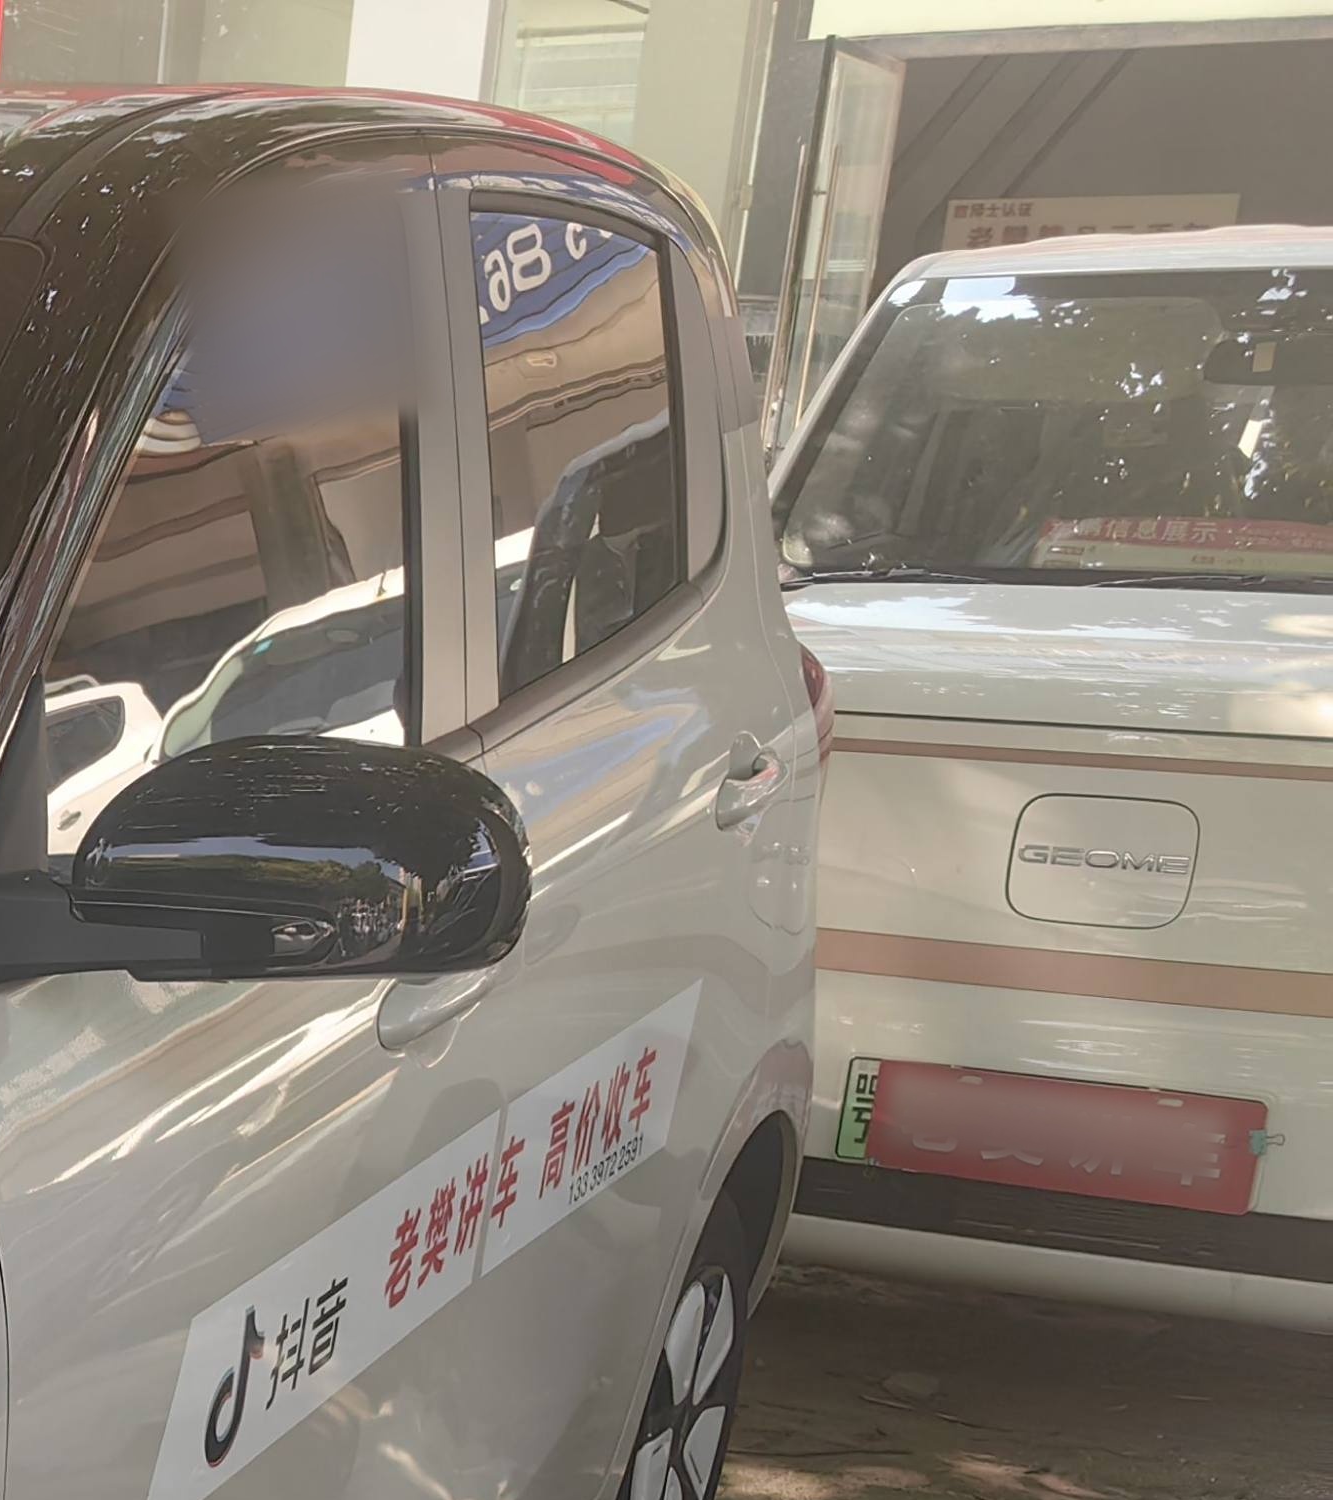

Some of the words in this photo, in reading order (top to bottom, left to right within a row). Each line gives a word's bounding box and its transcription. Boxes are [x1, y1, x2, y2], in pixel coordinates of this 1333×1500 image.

[1018, 844, 1191, 875] GEOME
[265, 1277, 349, 1411] 抖音
[384, 1135, 526, 1309] 老樊讲车
[538, 1046, 657, 1200] 高价收车
